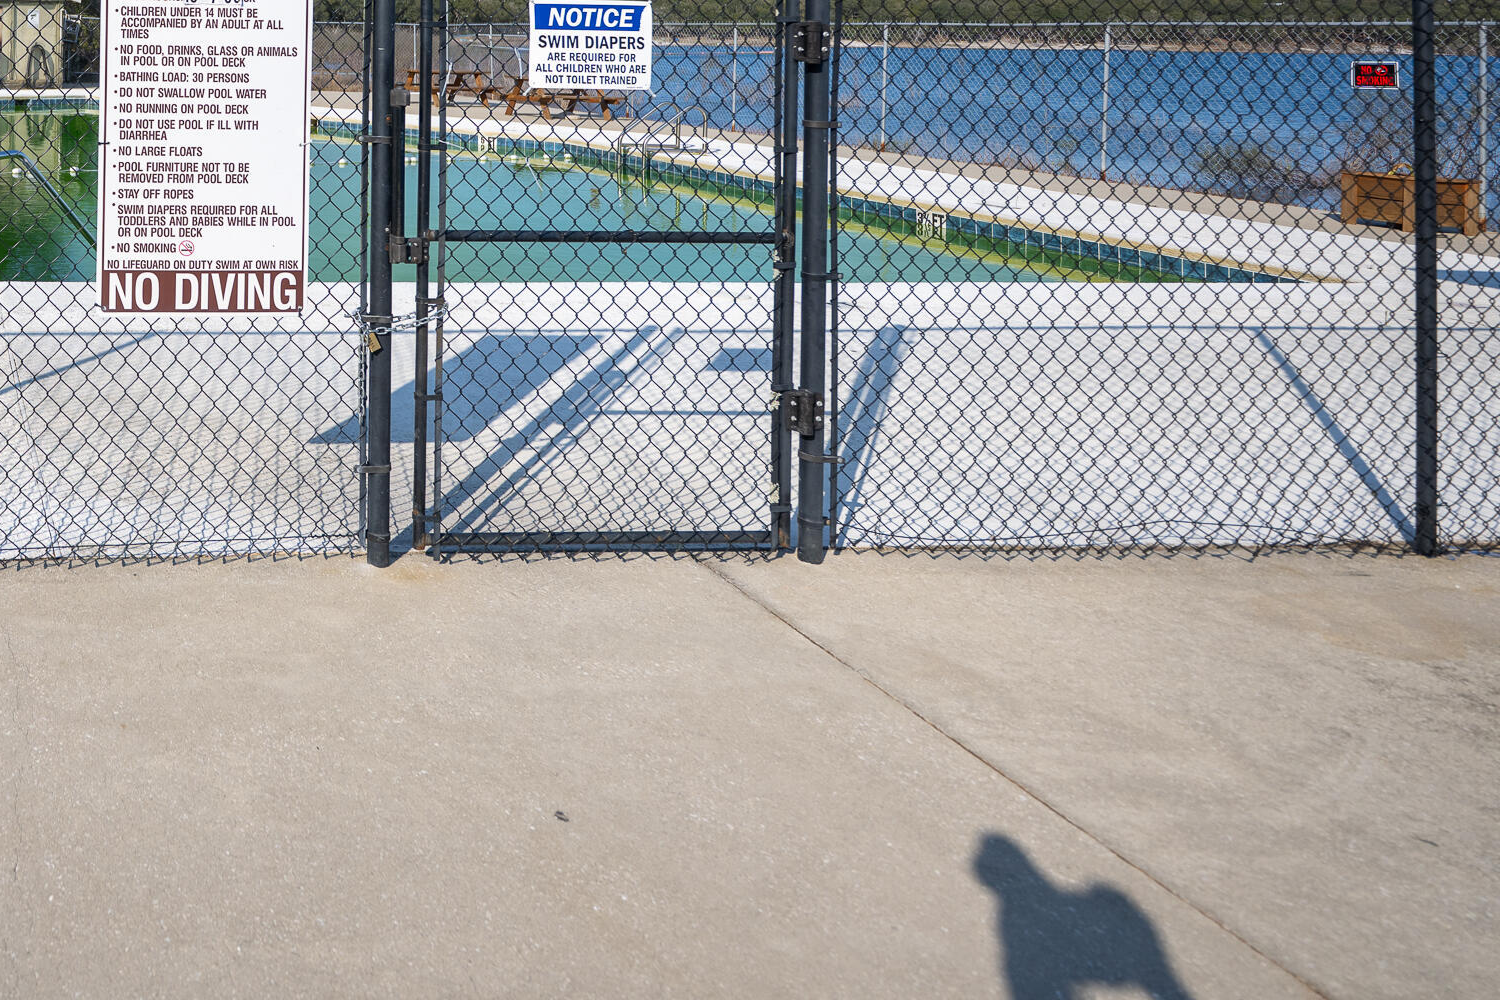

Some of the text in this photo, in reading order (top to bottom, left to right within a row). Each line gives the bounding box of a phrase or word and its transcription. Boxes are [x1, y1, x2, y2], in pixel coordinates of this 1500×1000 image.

[120, 6, 258, 18] CHILDREN UNDER 14 MUST BE
[548, 7, 635, 28] NOTICE
[120, 17, 284, 30] ACCOMPANIED BY AN ADULT AT ALL
[121, 29, 149, 39] TIMES
[538, 35, 645, 50] SWIM DIAPERS
[120, 44, 298, 57] NO FOOD, DRINKS, GLASS OR ANIMALS
[120, 55, 246, 68] IN POOL OR ON POOL DECK
[547, 52, 636, 63] ARE REQUIRED FOR
[535, 63, 647, 74] ALL CHILDREN WHO ARE
[1360, 65, 1372, 75] NO
[119, 71, 250, 84] BATHING LOAD: 30 PERSONS
[545, 75, 637, 85] NOT TOILET TRAINED
[119, 87, 267, 100] DO NOT SWALLOW POOL WATER
[119, 103, 249, 115] NO RUNNING ON POOL DECK
[119, 119, 259, 131] DO NOT USE POOL IF ILL WITH
[119, 130, 168, 141] DIARRHEA
[118, 146, 203, 157] NO LARGE FLOATS
[118, 162, 250, 173] POOL FURNITURE NOT TO BE
[118, 173, 249, 184] REMOVED FROM POOL DECK
[117, 188, 194, 200] STAY OFF ROPES
[117, 204, 278, 216] SWIM DIAPERS REQUIRED FOR ALL
[117, 216, 296, 227] TODDLERS AND BABIES WHILE IN POOL
[117, 227, 203, 238] OR ON POOL DECK
[116, 242, 177, 253] NO SMOKING
[107, 259, 299, 270] NO LIFEGUARD ON DUTY SWIM AT OWN RISK
[108, 272, 297, 311] NO DIVING
